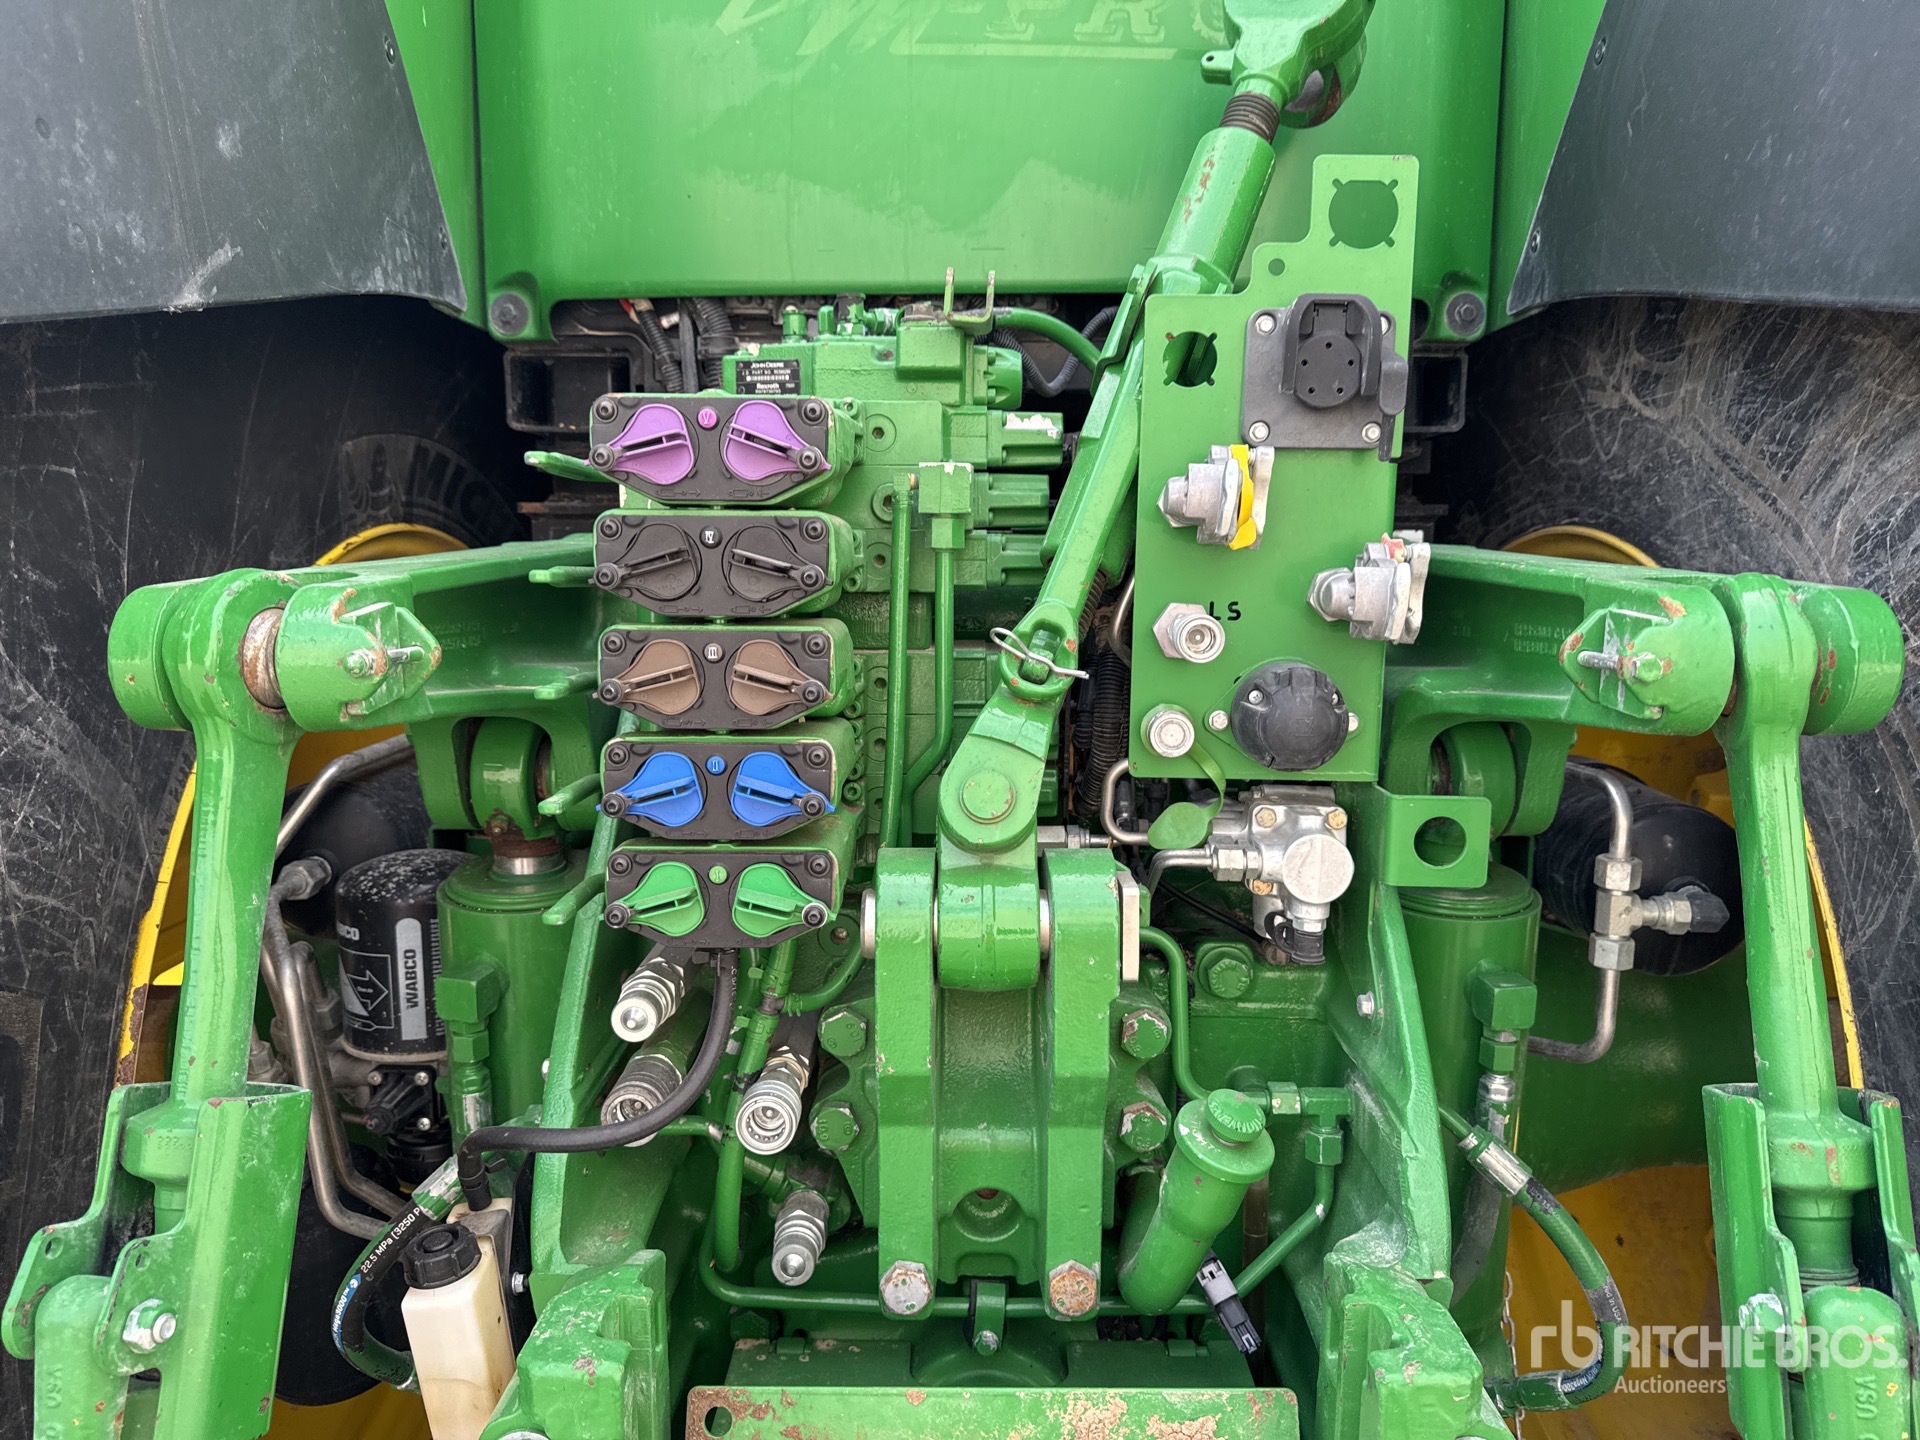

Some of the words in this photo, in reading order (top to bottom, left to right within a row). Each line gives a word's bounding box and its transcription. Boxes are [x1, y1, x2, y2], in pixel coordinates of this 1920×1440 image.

[708, 646, 718, 658] III
[403, 949, 420, 1010] WABCO
[360, 1253, 378, 1274] 22.5
[375, 1237, 394, 1256] MPa
[392, 1212, 416, 1240] (3250
[1611, 1305, 1622, 1322] USA
[1855, 1376, 1877, 1420] USA
